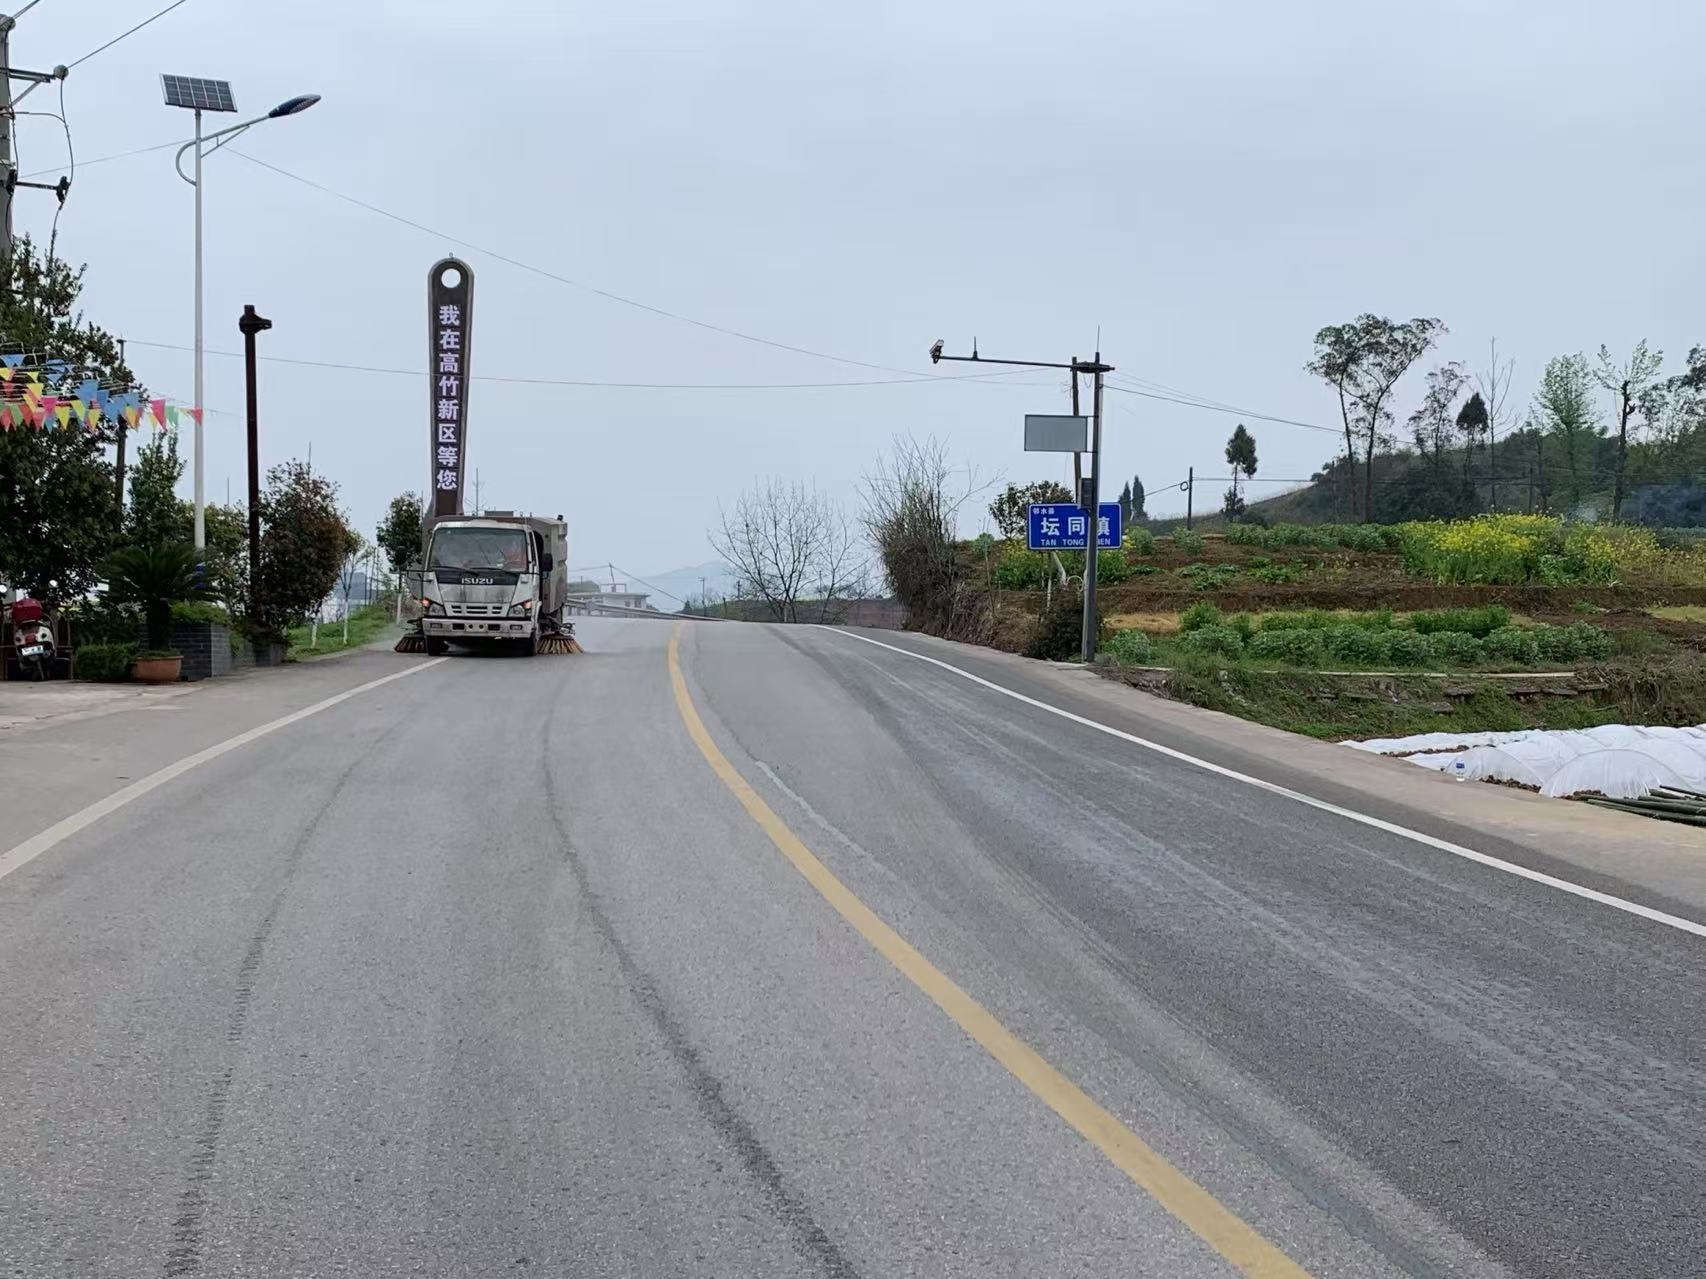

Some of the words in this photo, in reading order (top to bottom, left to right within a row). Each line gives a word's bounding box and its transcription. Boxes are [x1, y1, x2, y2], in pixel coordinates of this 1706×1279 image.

[437, 304, 460, 491] 我在高竹新区等您
[1062, 538, 1084, 546] TONG
[461, 577, 494, 585] ISUZU
